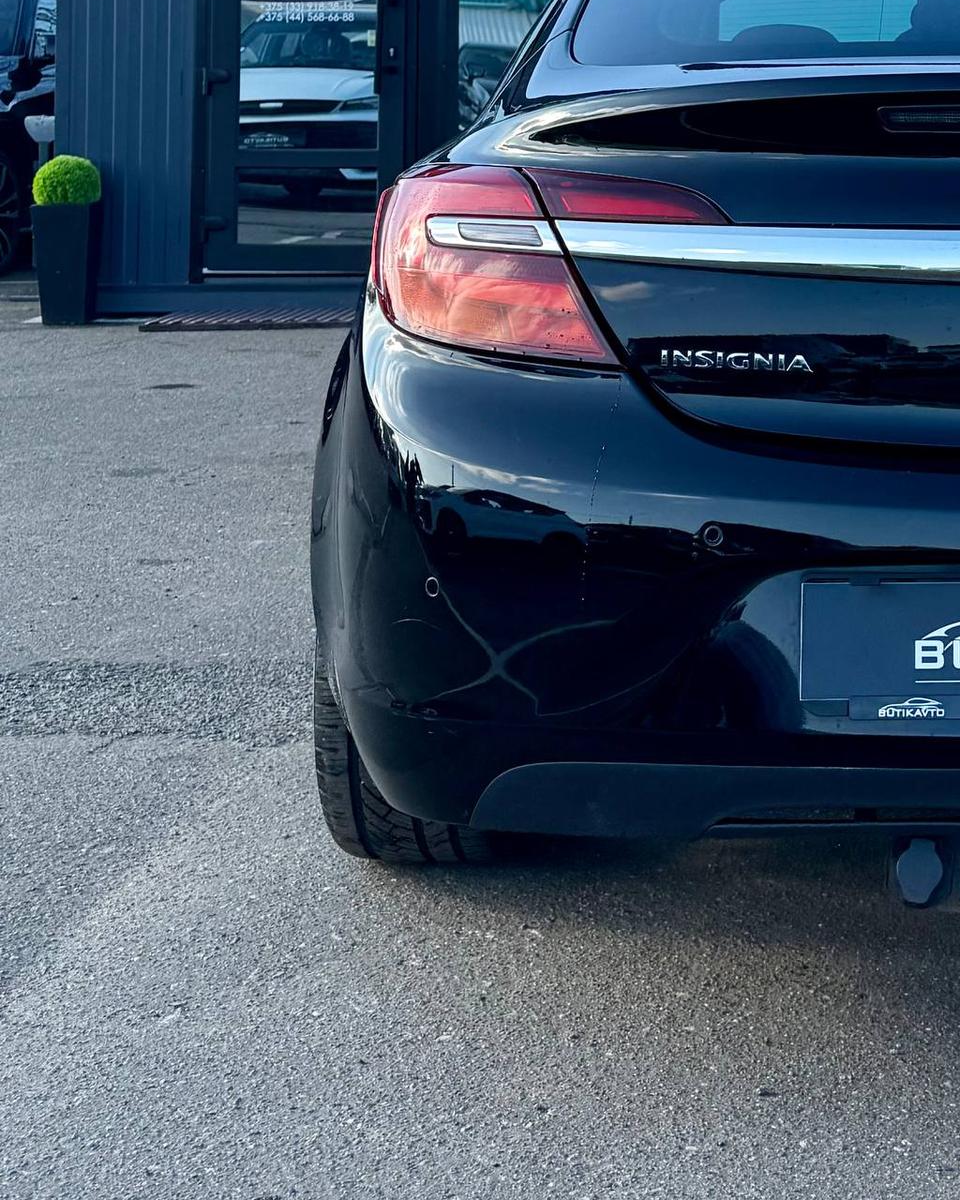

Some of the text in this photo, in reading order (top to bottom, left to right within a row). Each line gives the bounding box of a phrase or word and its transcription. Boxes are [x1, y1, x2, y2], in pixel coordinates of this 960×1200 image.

[286, 12, 304, 23] (44)
[307, 12, 355, 22] 568-66-88
[660, 349, 814, 373] INSIGNIA
[878, 707, 945, 717] BUTIKAVTO
